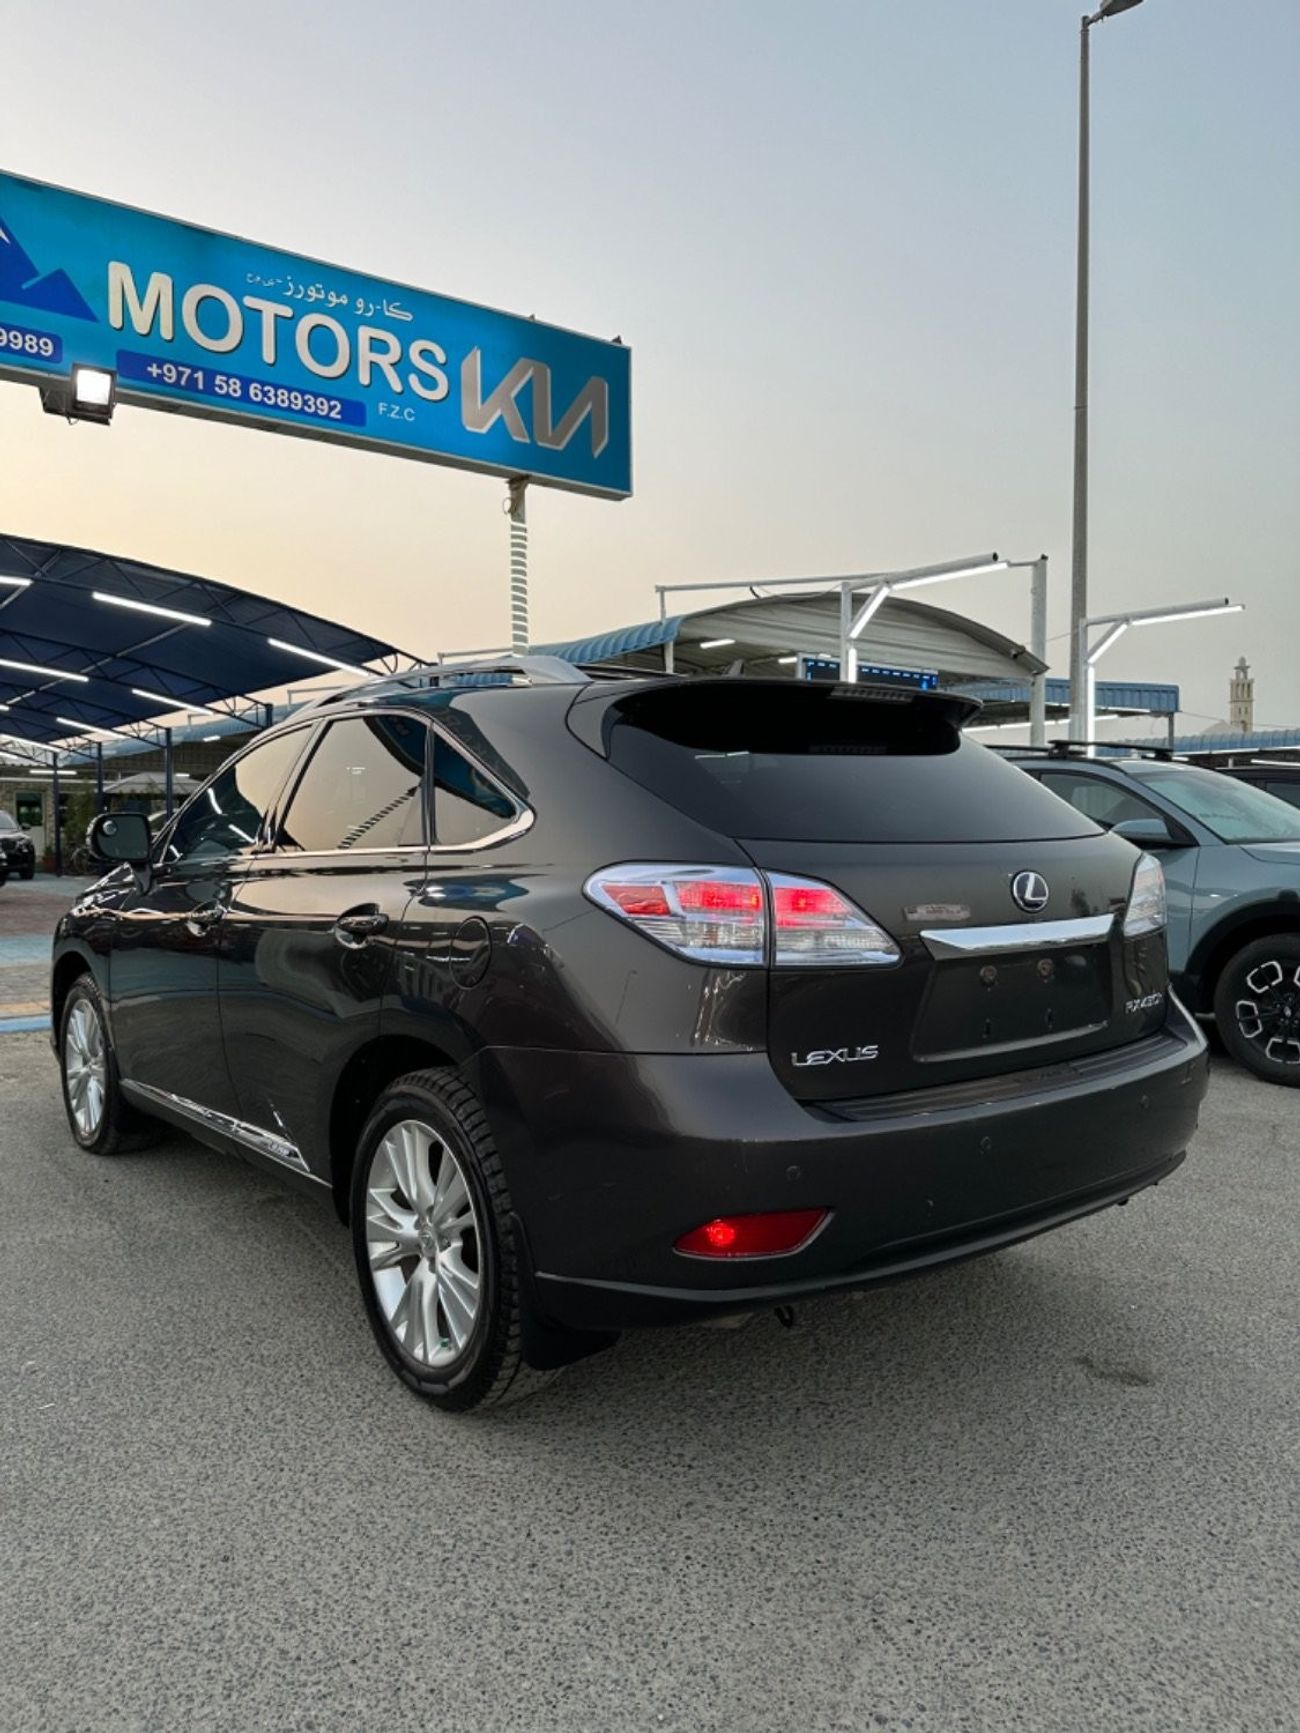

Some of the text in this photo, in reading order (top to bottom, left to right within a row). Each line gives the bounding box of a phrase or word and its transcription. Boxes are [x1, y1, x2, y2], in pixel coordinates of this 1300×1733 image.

[108, 261, 449, 401] MOTORS
[147, 362, 342, 420] +971 58 6389392
[790, 1044, 879, 1067] LEXUS
